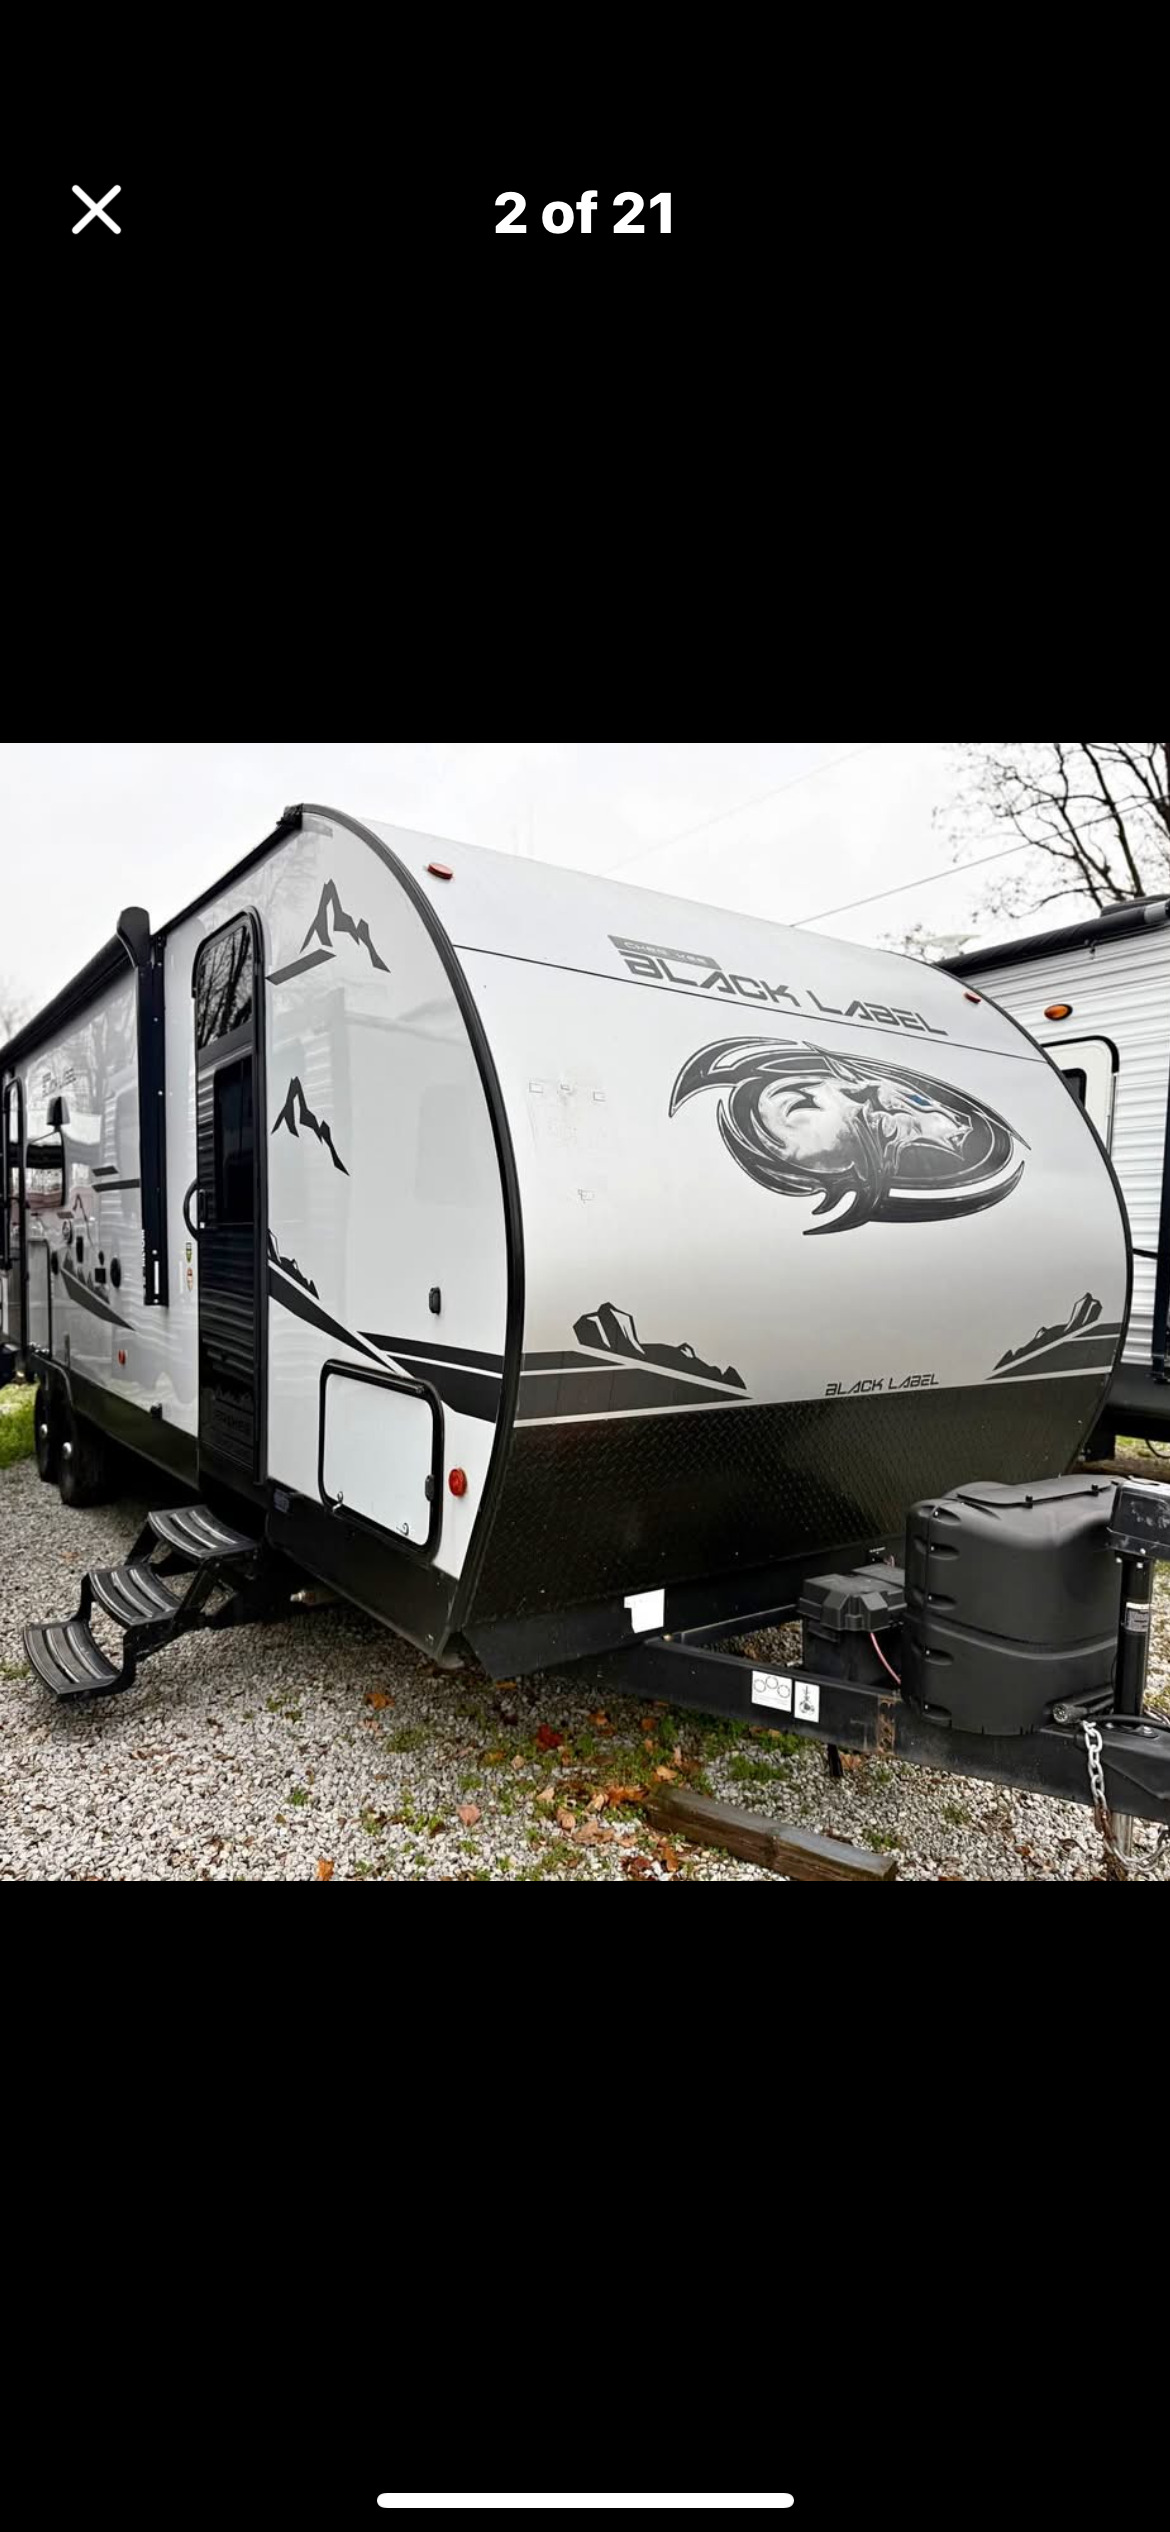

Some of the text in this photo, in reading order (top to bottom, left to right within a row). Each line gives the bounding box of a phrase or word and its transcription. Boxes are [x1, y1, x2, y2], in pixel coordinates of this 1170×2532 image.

[618, 949, 949, 1036] BLACK LABEL
[824, 1373, 940, 1397] BLACK LABEL
